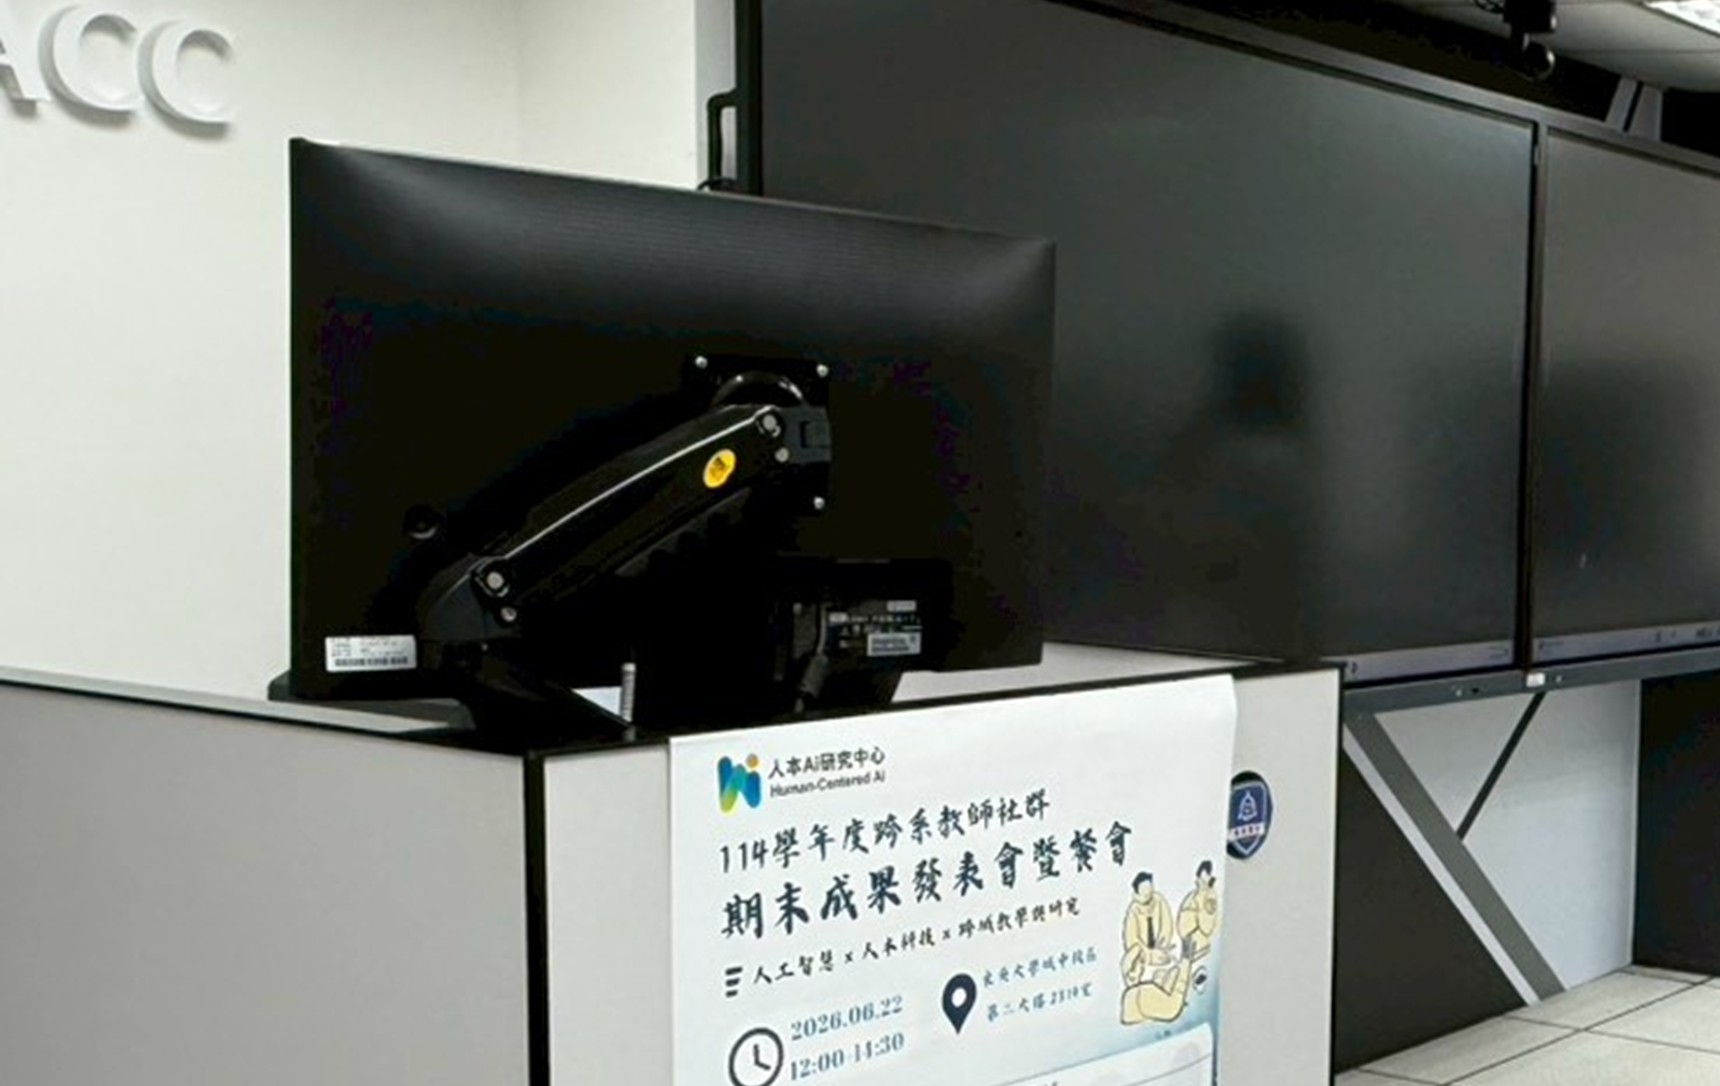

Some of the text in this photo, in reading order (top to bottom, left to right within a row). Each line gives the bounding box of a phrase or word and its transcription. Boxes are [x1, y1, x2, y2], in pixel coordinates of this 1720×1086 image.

[770, 771, 871, 797] Human-Centered
[720, 788, 1051, 874] 114學年度跨系教師社群
[721, 821, 1133, 940] 期末成果發表會暨餐會
[790, 994, 904, 1041] 2026.06.22
